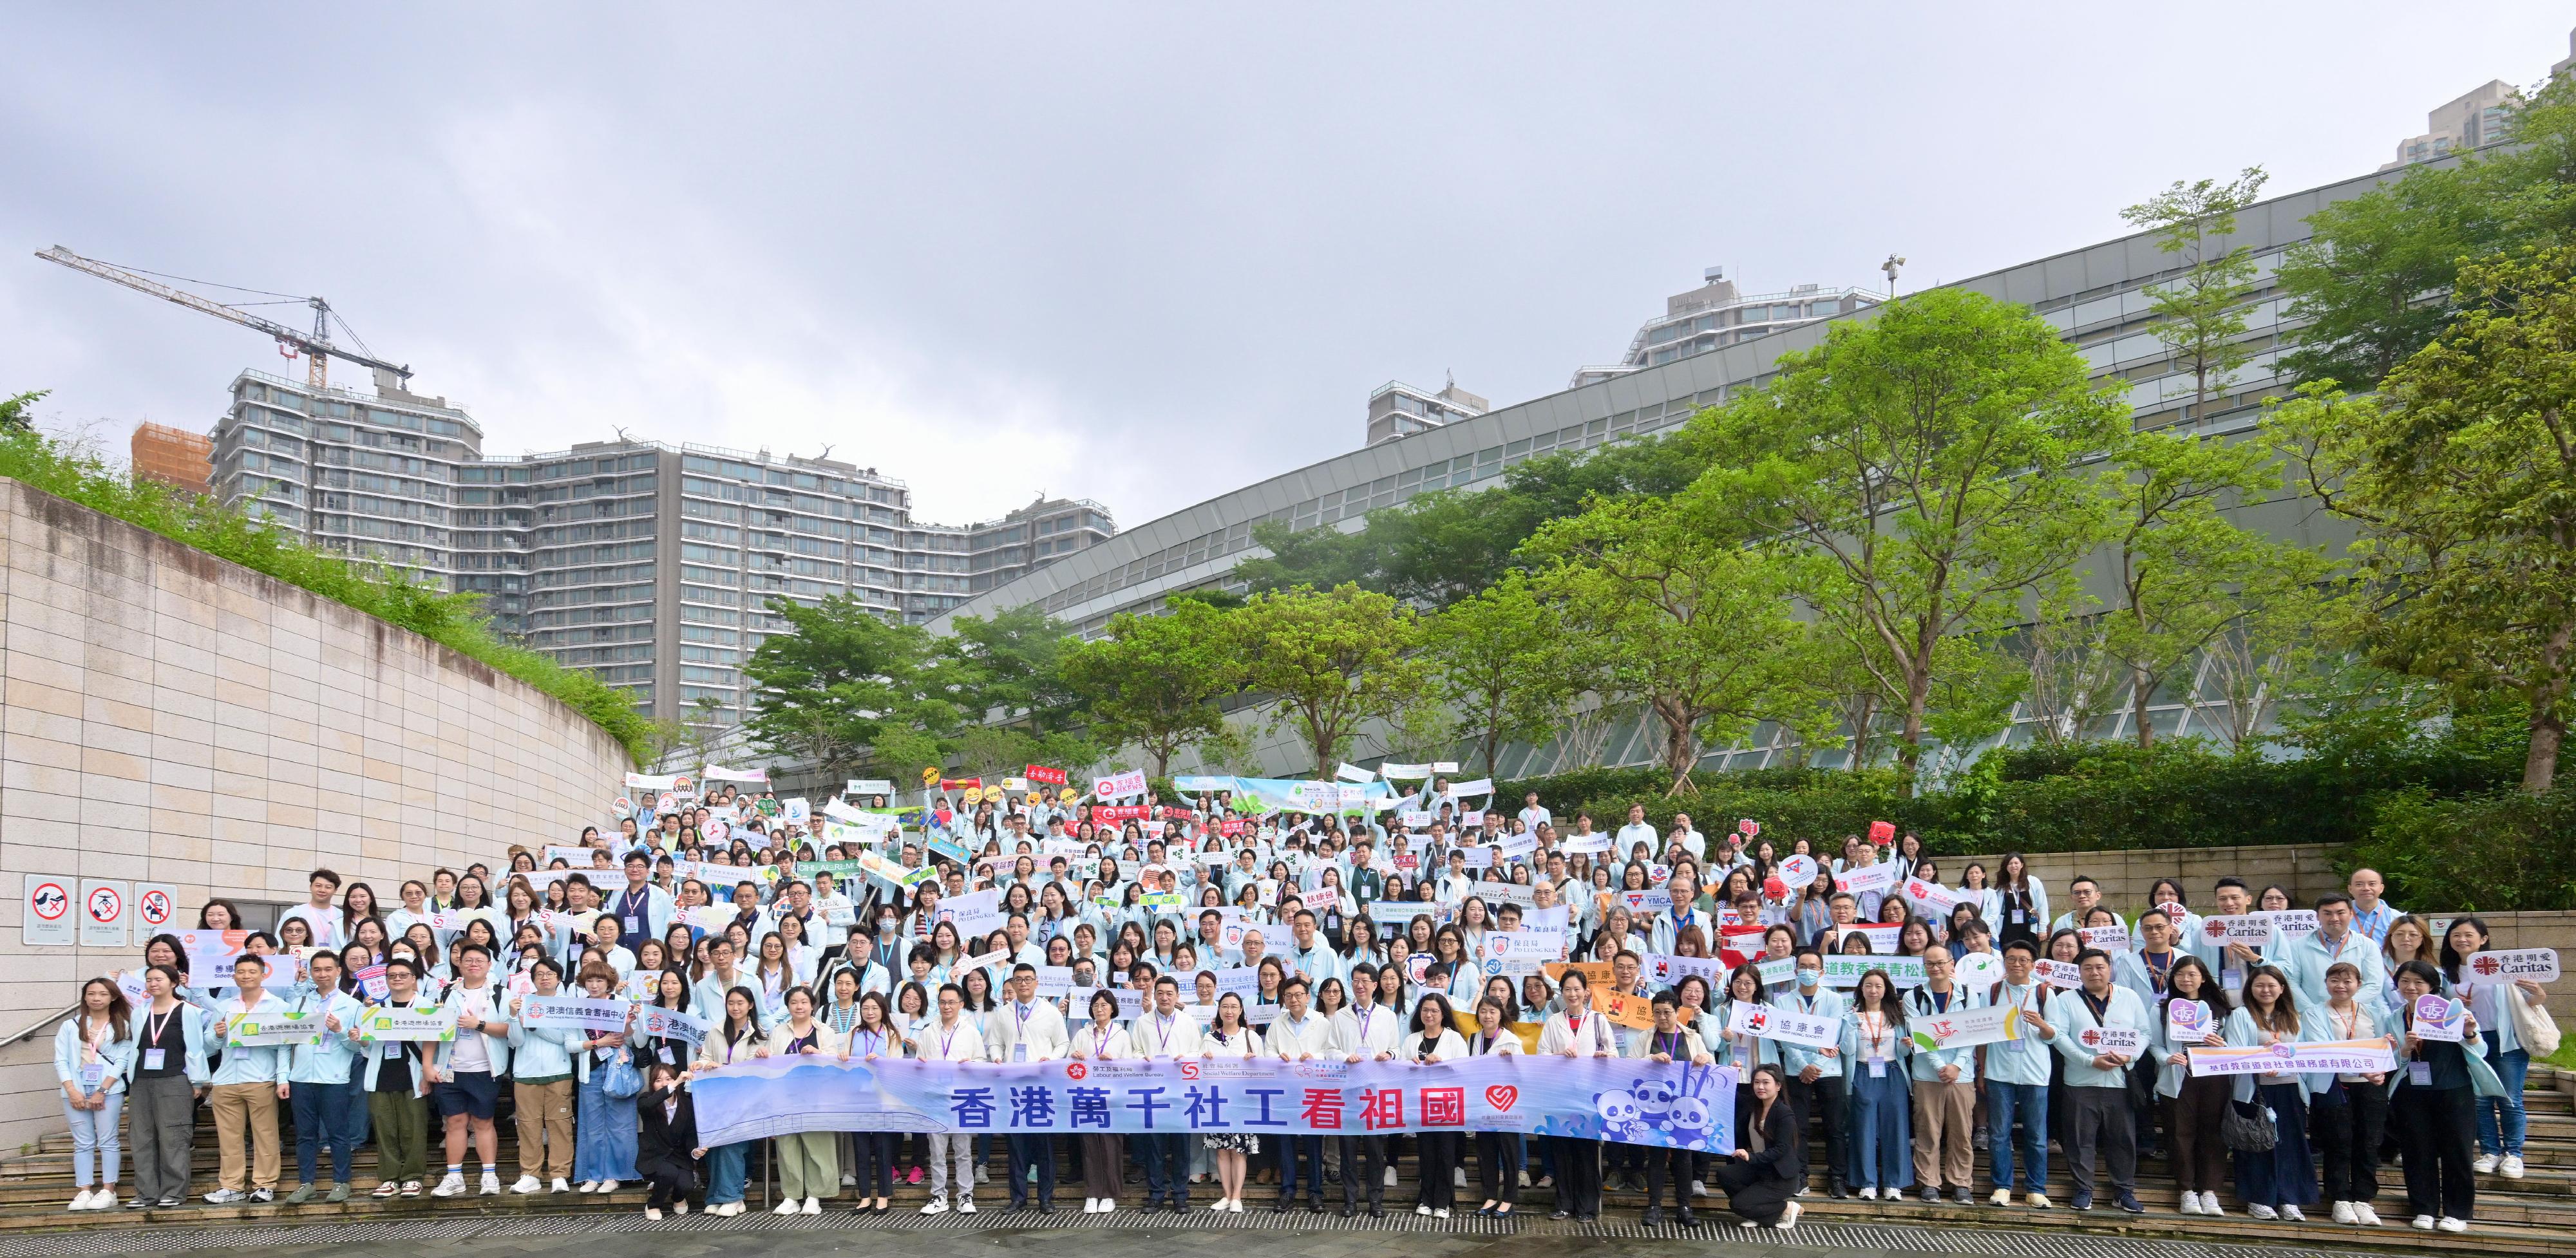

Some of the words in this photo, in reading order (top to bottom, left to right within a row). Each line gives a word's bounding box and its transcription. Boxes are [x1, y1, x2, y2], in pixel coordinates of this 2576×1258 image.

[1116, 775, 1141, 787] 家福會
[1117, 783, 1143, 793] HKFWS
[907, 870, 933, 883] YWCA
[1146, 896, 1175, 905] YWCA
[1307, 890, 1334, 903] 扶康會
[2227, 919, 2268, 927] 香港明愛
[2227, 926, 2268, 937] Caritas
[2094, 934, 2126, 943] Caritas
[2501, 952, 2551, 963] 香港明愛
[214, 964, 235, 973] 善導
[2054, 964, 2078, 973] 香港明
[2500, 962, 2552, 973] Caritas
[1587, 970, 1611, 981] 協康
[1781, 1019, 1825, 1035] 協康會
[2101, 1030, 2136, 1038] 香港明愛
[2101, 1037, 2136, 1047] Caritas
[2210, 1058, 2374, 1072] 基督教宣道會社會服務處有限公司
[951, 1085, 1465, 1130] 香港萬千社工看祖國
